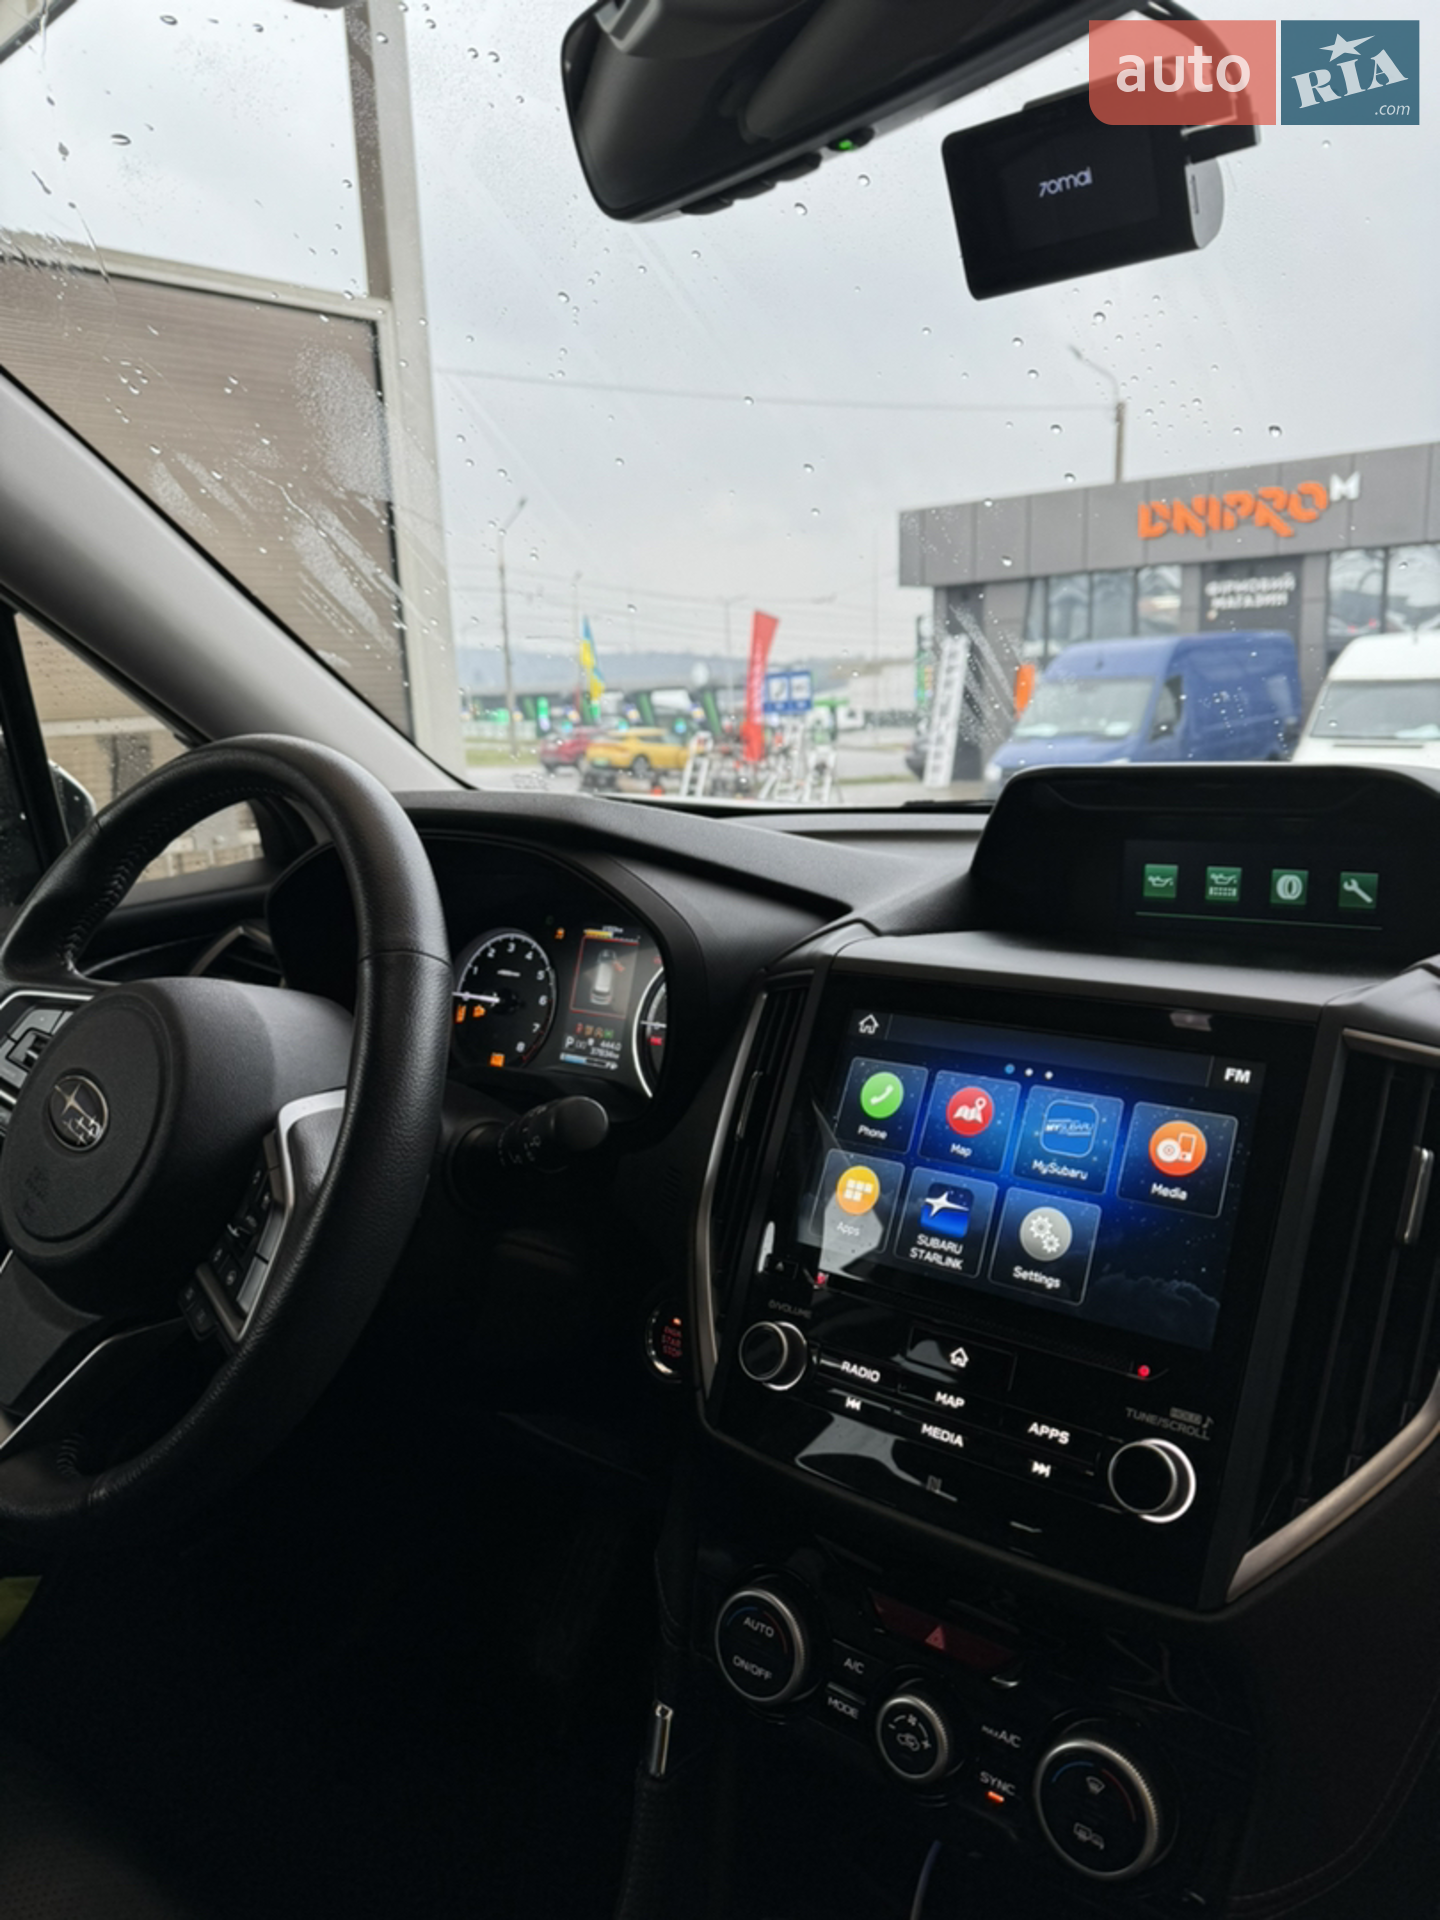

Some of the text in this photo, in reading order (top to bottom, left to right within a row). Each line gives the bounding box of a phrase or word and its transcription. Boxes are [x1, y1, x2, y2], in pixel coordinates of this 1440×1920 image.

[1137, 480, 1329, 541] DNIPRO
[507, 942, 516, 953] 3
[525, 951, 534, 961] 4
[538, 995, 548, 1006] 6
[1224, 1067, 1252, 1085] FM
[857, 1124, 888, 1141] Phone
[950, 1142, 971, 1158] Map
[1032, 1158, 1089, 1181] MySubaru
[1151, 1181, 1188, 1201] Media
[836, 1221, 861, 1237] Apps
[916, 1233, 963, 1255] SUBARU
[909, 1246, 965, 1271] STARLINK
[1012, 1265, 1061, 1289] Settings
[840, 1359, 881, 1383] RADIO
[934, 1391, 966, 1409] MAP
[920, 1422, 965, 1448] MEDIA
[1027, 1421, 1071, 1445] APPS
[1125, 1406, 1210, 1441] TUNE/SCROLL
[743, 1615, 776, 1639] AUTO
[732, 1655, 774, 1682] ON/OFF
[843, 1657, 866, 1676] A/C
[827, 1696, 860, 1720] MODE
[979, 1770, 1017, 1797] SYNC
